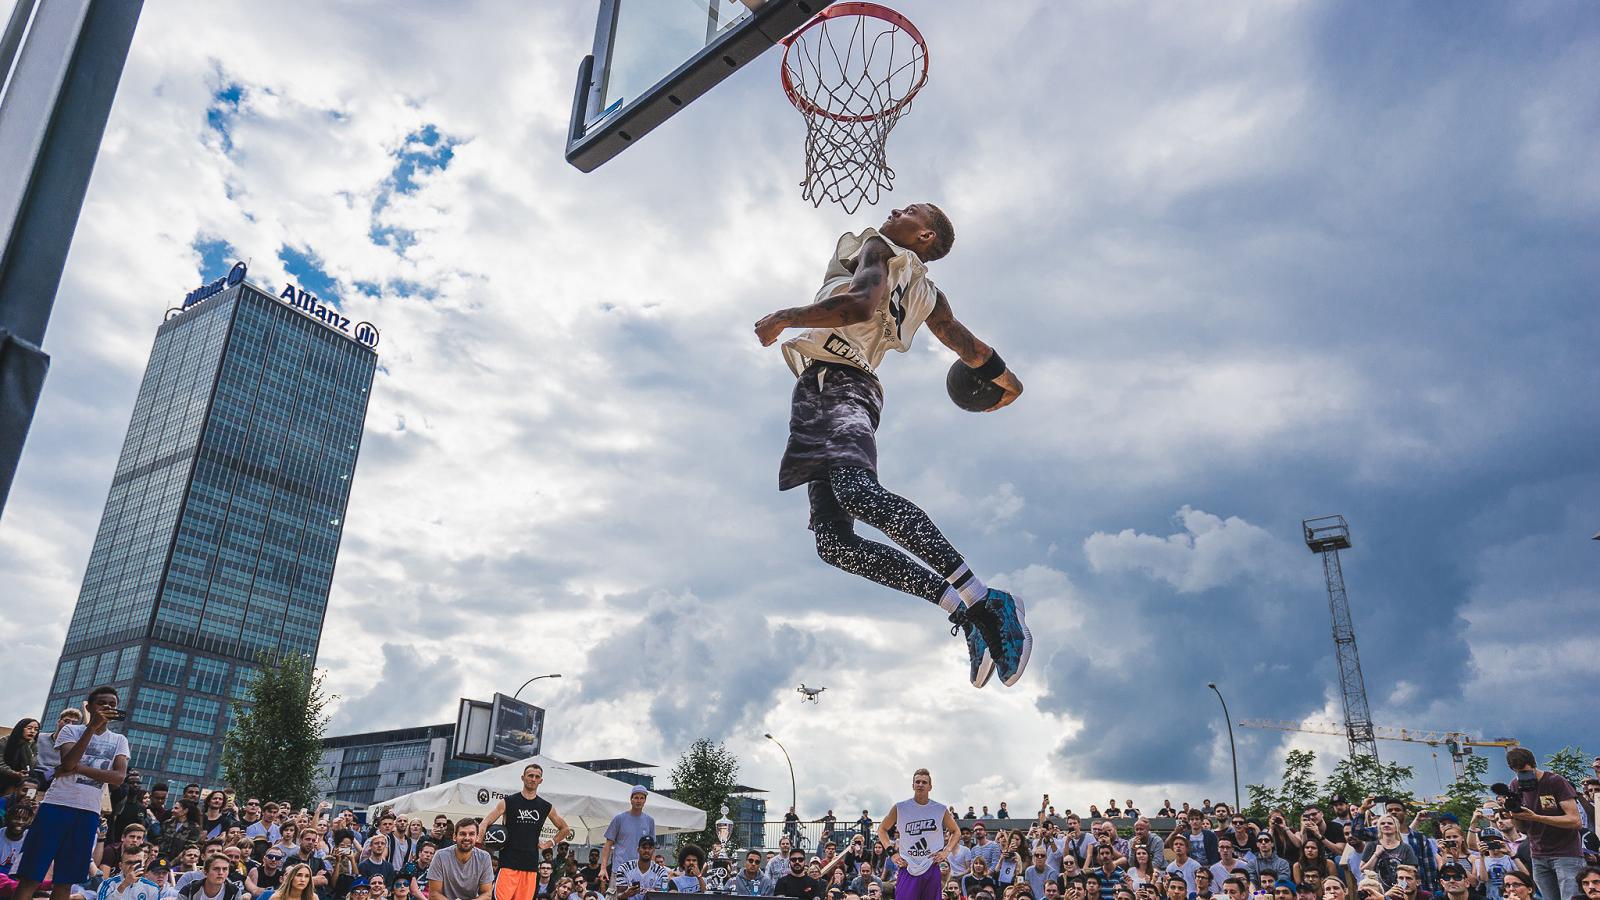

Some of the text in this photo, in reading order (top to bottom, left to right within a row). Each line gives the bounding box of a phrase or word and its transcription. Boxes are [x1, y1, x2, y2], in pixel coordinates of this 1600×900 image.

[280, 283, 351, 332] Allianz
[908, 848, 932, 857] adidas
[1005, 867, 1012, 875] 6
